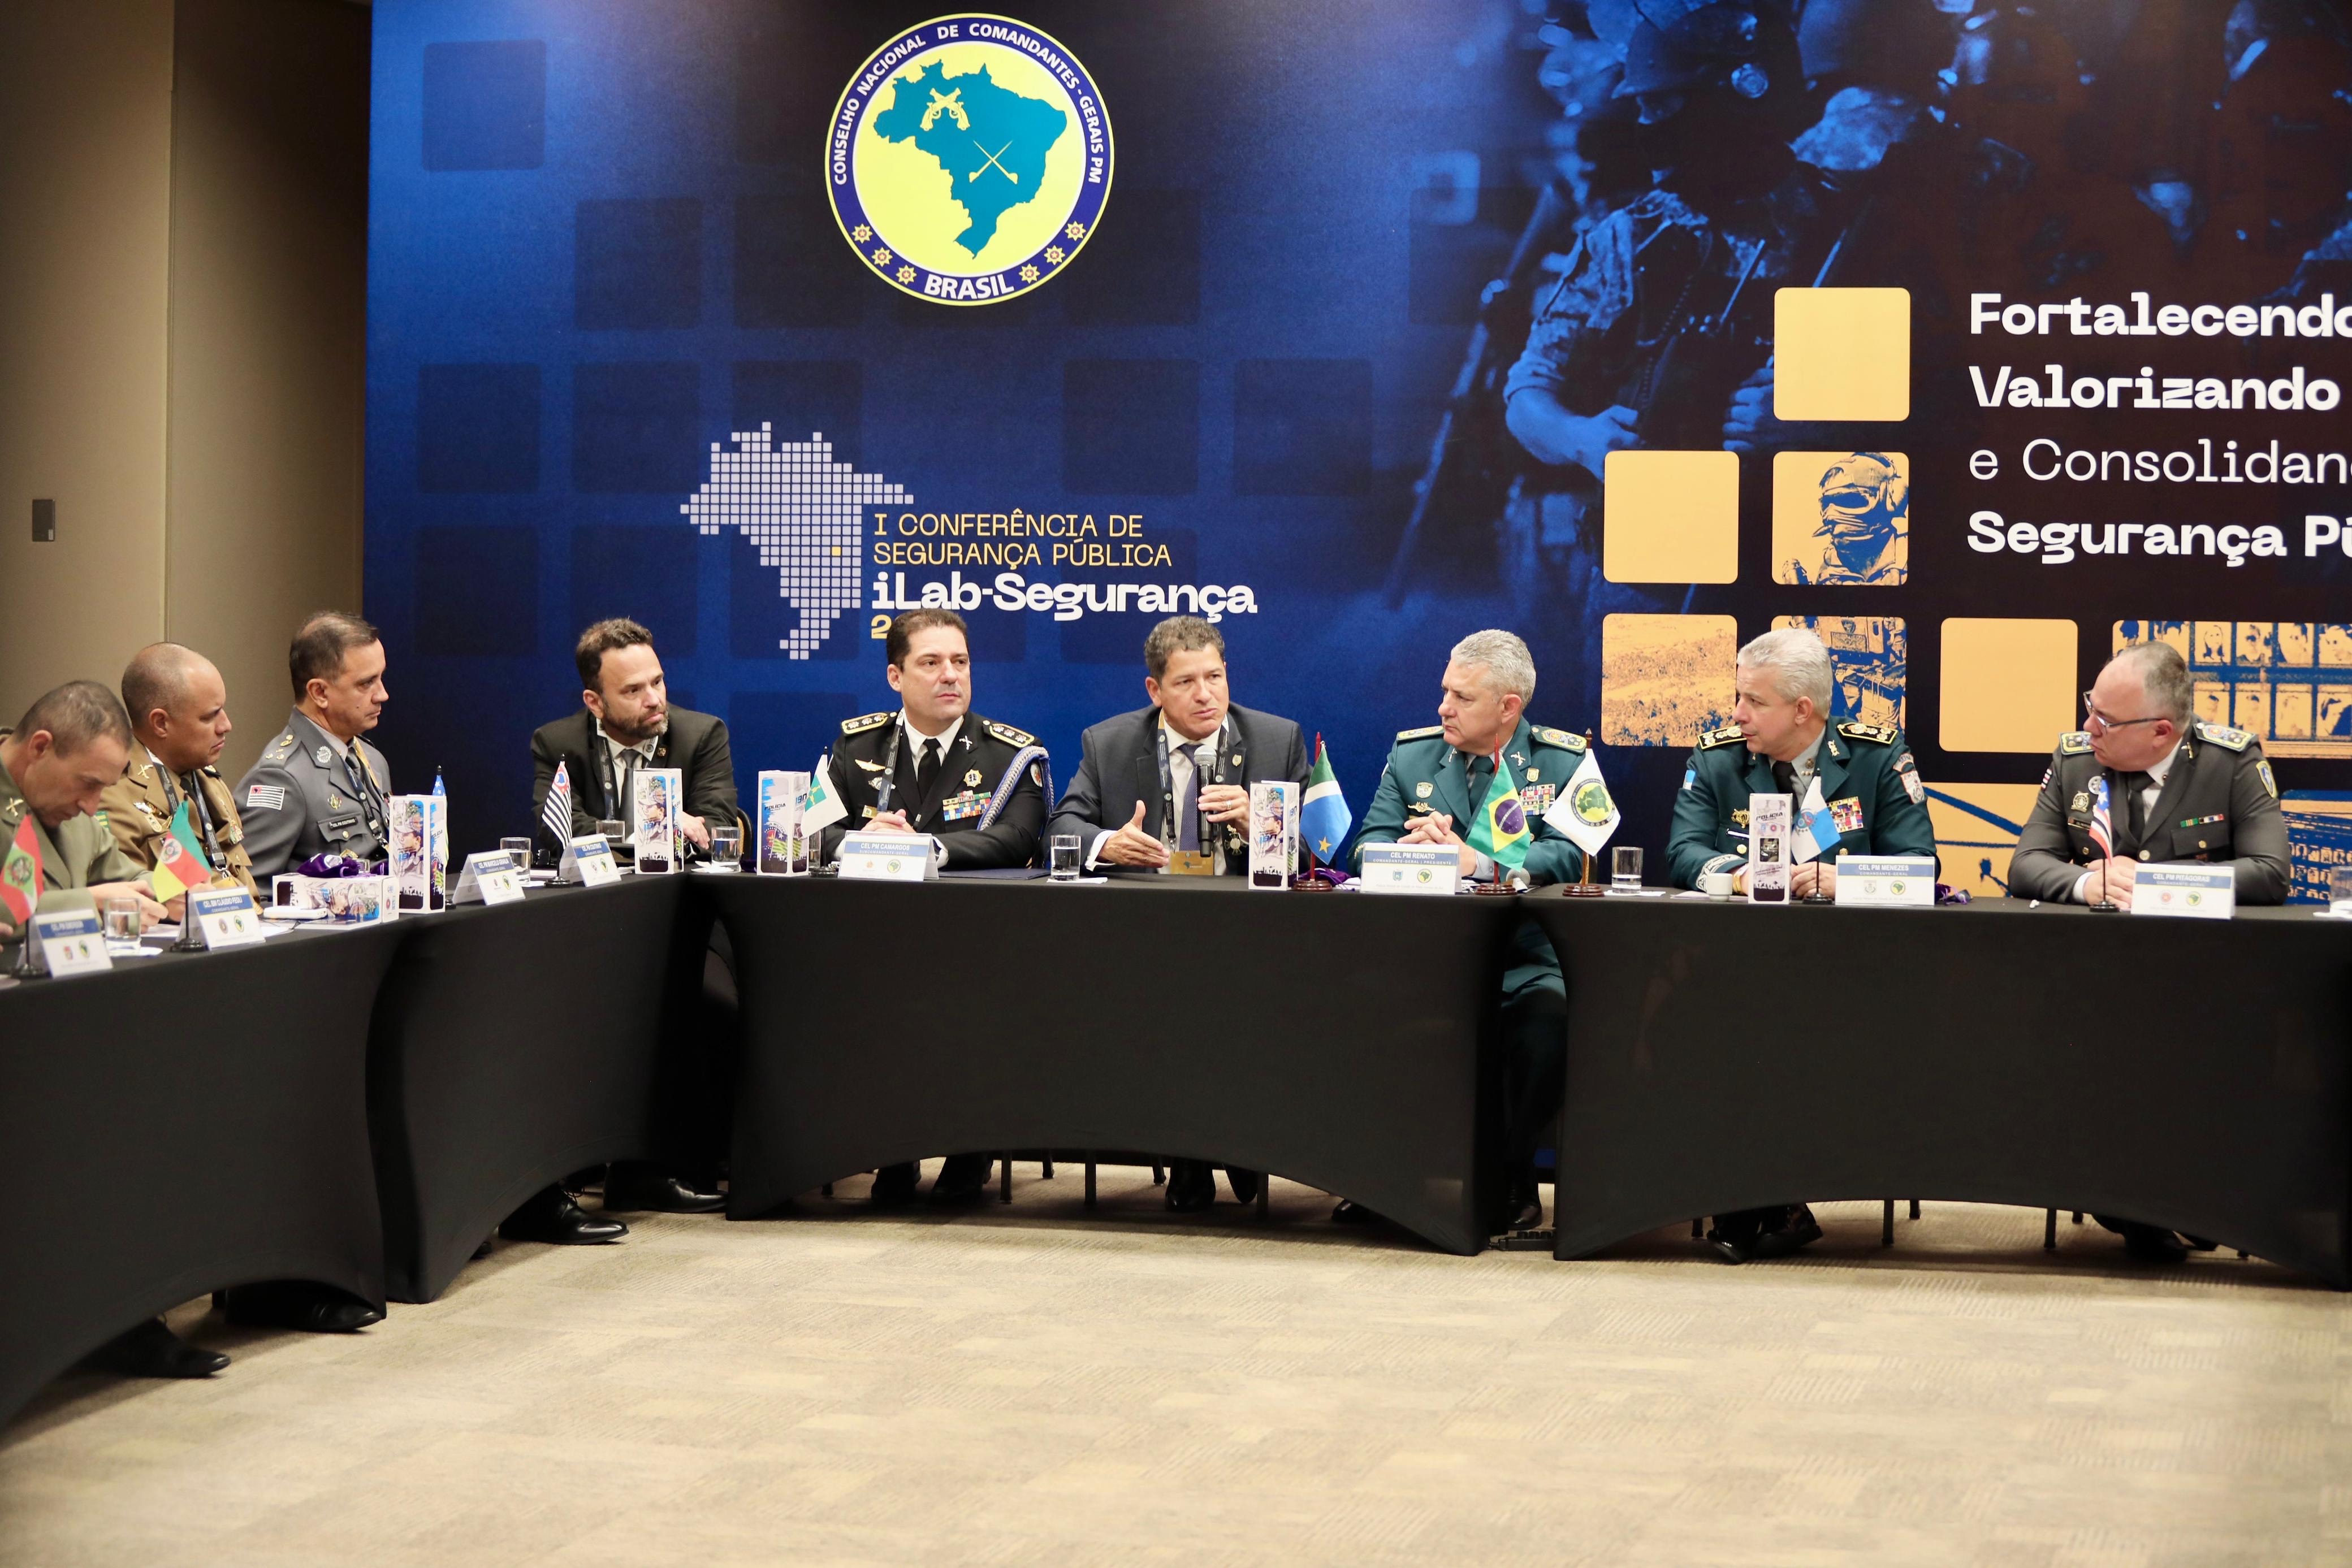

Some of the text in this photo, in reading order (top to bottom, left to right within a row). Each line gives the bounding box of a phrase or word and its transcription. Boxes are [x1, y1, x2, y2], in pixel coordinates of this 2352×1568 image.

[834, 98, 860, 185] CONSELHO
[857, 34, 926, 97] NACIONAL
[937, 24, 959, 40] DE
[1088, 156, 1103, 183] PM
[924, 274, 1015, 300] BRASIL
[1969, 365, 2340, 410] Valorizando
[1969, 439, 2352, 484] e Consolidan
[874, 508, 1143, 537] I CONFERÊNCIA DE
[1968, 511, 2287, 567] Segurança
[874, 538, 1172, 570] SEGURANÇA PÚBLICA
[871, 571, 1258, 623] iLab-Segurança
